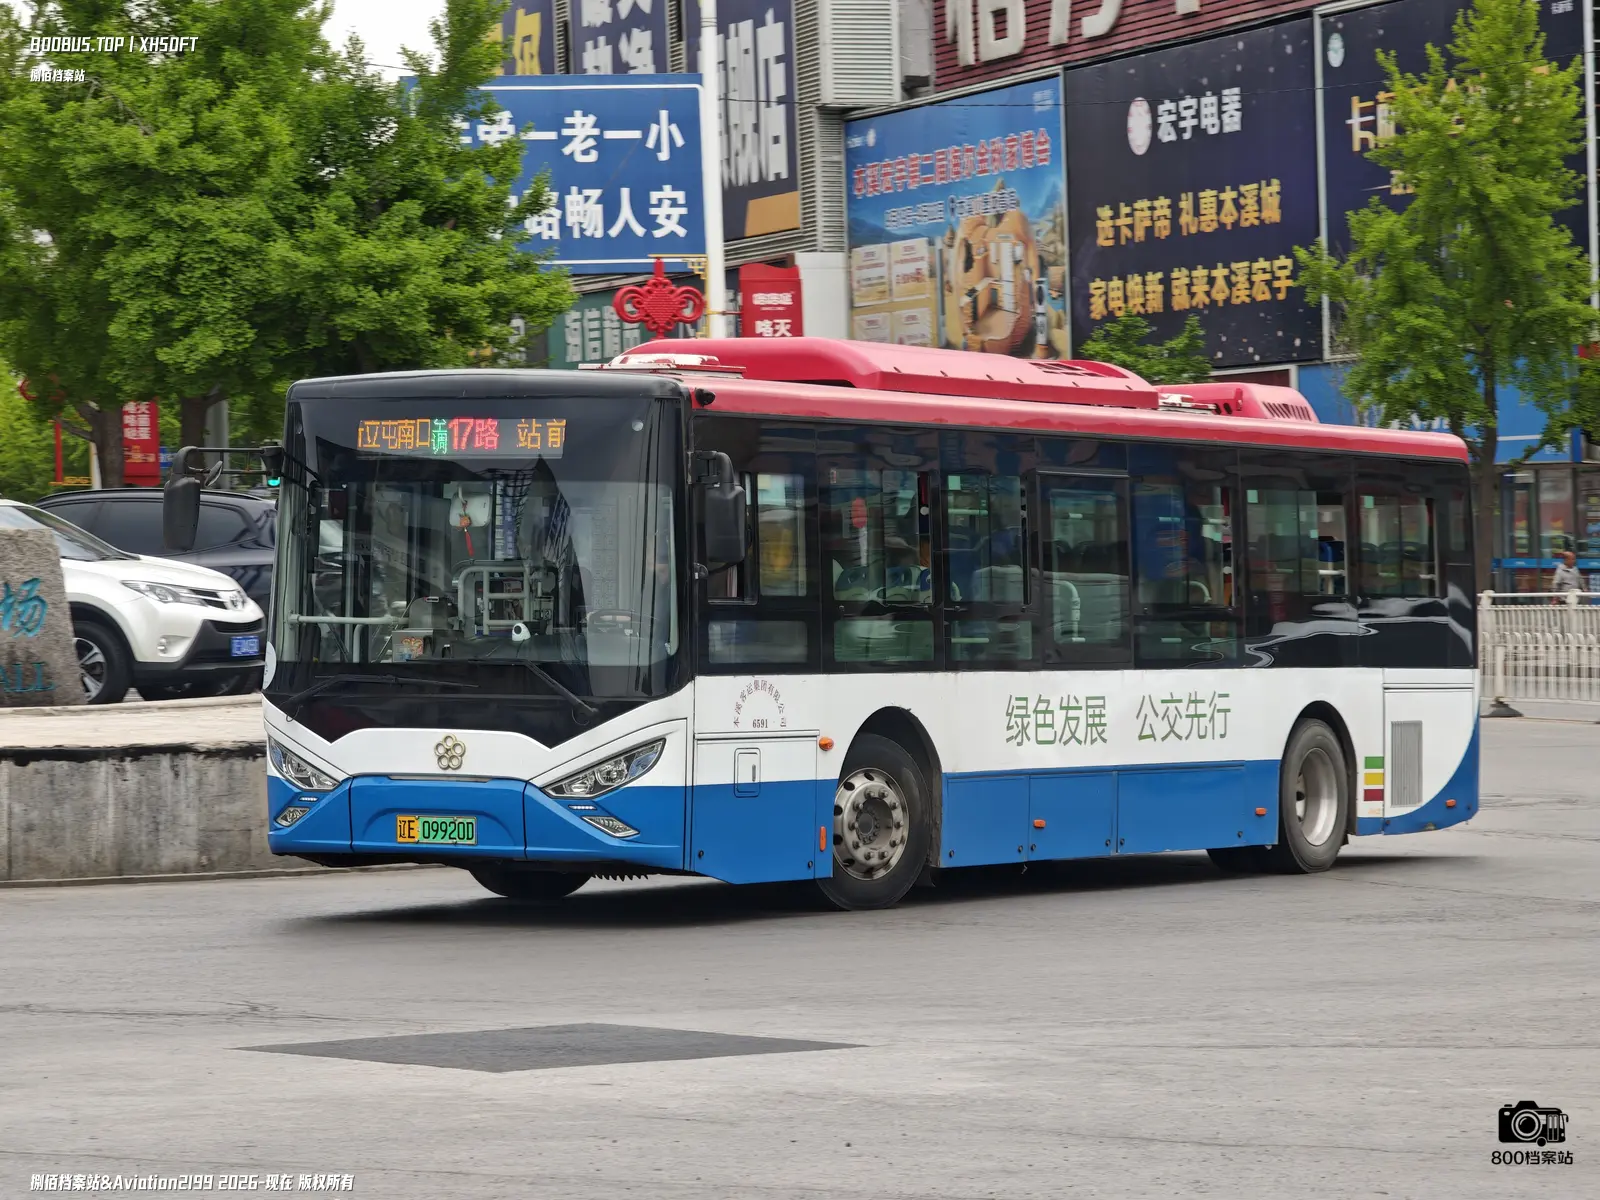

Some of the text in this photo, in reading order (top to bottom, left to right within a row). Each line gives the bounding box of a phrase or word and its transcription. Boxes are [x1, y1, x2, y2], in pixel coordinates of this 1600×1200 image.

[1157, 87, 1242, 143] 宏宇电器
[488, 184, 689, 241] 路畅人安
[1096, 178, 1281, 247] 选卡萨帝 礼惠本溪城
[1089, 255, 1294, 320] 家电焕新 就来本溪宏宇
[448, 417, 500, 450] 17路
[516, 418, 566, 449] 站前
[752, 718, 768, 728] 6591
[1005, 690, 1231, 747] 绿色发展 公交先行
